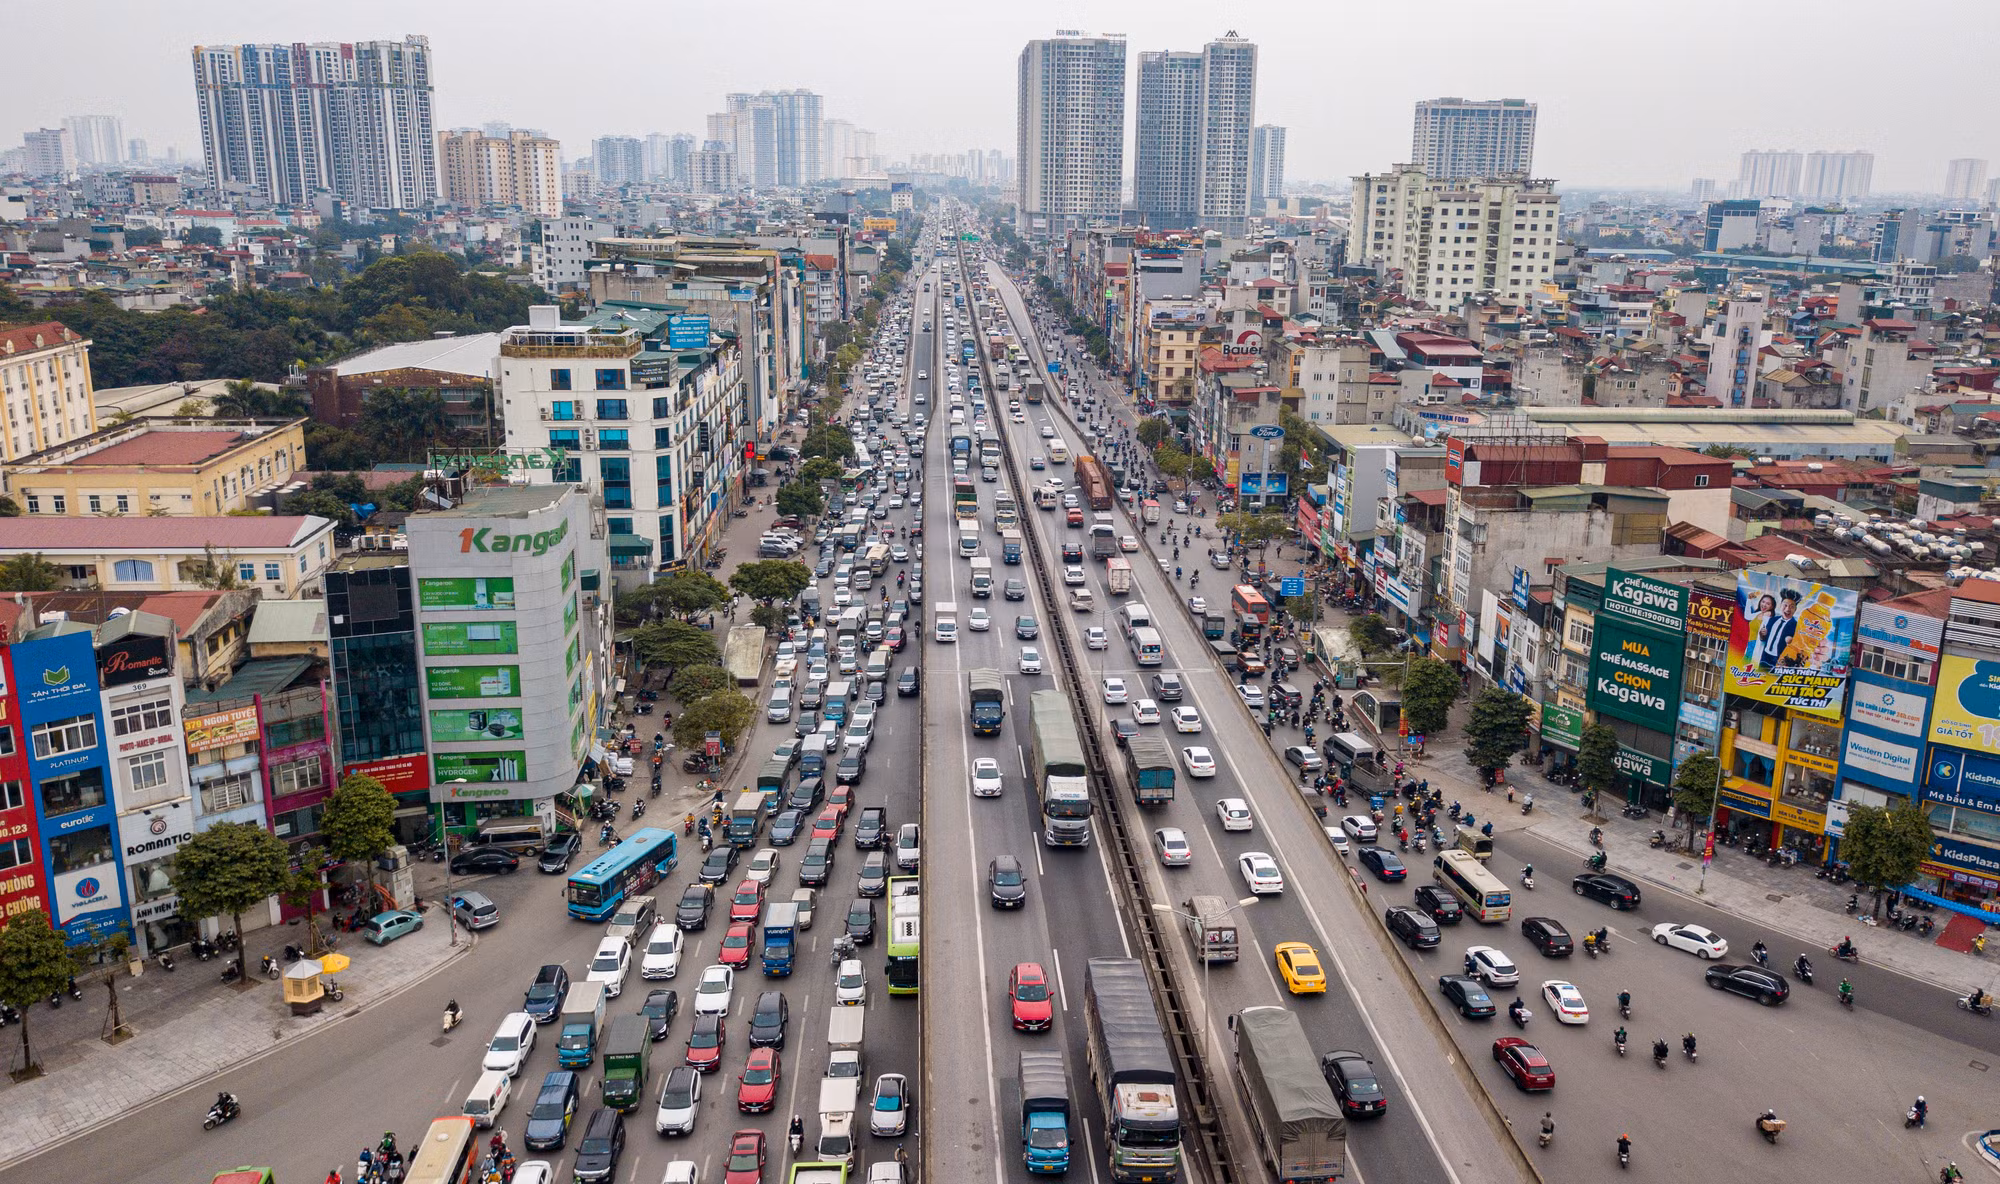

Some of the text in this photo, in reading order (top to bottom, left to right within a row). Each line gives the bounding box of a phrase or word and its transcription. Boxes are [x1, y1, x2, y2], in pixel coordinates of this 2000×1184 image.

[1223, 344, 1263, 355] Bauer
[1257, 427, 1279, 437] Ford
[1612, 580, 1678, 612] Kagawa
[1624, 577, 1680, 598] GHẾ MASSAGE
[1688, 602, 1733, 623] TOPY
[1622, 640, 1650, 657] MUA
[104, 651, 164, 674] Romantic
[148, 667, 169, 676] Studio
[1600, 652, 1670, 679] GHẾ MASSAGE
[1614, 671, 1651, 691] CHỌN
[1730, 665, 1762, 679] Number
[132, 682, 147, 692] 369
[1803, 675, 1840, 688] MẠNH
[1597, 677, 1666, 711] Kagawa
[203, 713, 229, 727] NGON
[230, 707, 257, 720] TUYỆT
[1936, 726, 1953, 736] GIÁ
[1955, 728, 1974, 739] TỐT
[119, 742, 135, 752] PHOTO
[1850, 741, 1883, 757] Western
[1883, 751, 1911, 765] Digital
[50, 755, 89, 769] PLATINUM
[1622, 751, 1653, 767] MASSAGE
[438, 769, 478, 777] HYDROGEN
[1929, 790, 1945, 802] Mẹ
[1946, 792, 1966, 805] bầu
[1967, 798, 1975, 807] &
[1976, 800, 1993, 810] Em
[60, 813, 95, 829] eurotile
[127, 831, 192, 857] ROMANTIC
[1944, 848, 2000, 869] KidsPlaza
[0, 874, 35, 896] PHÒNG
[6, 895, 41, 916] CHỨNG
[153, 902, 172, 914] VIỆN
